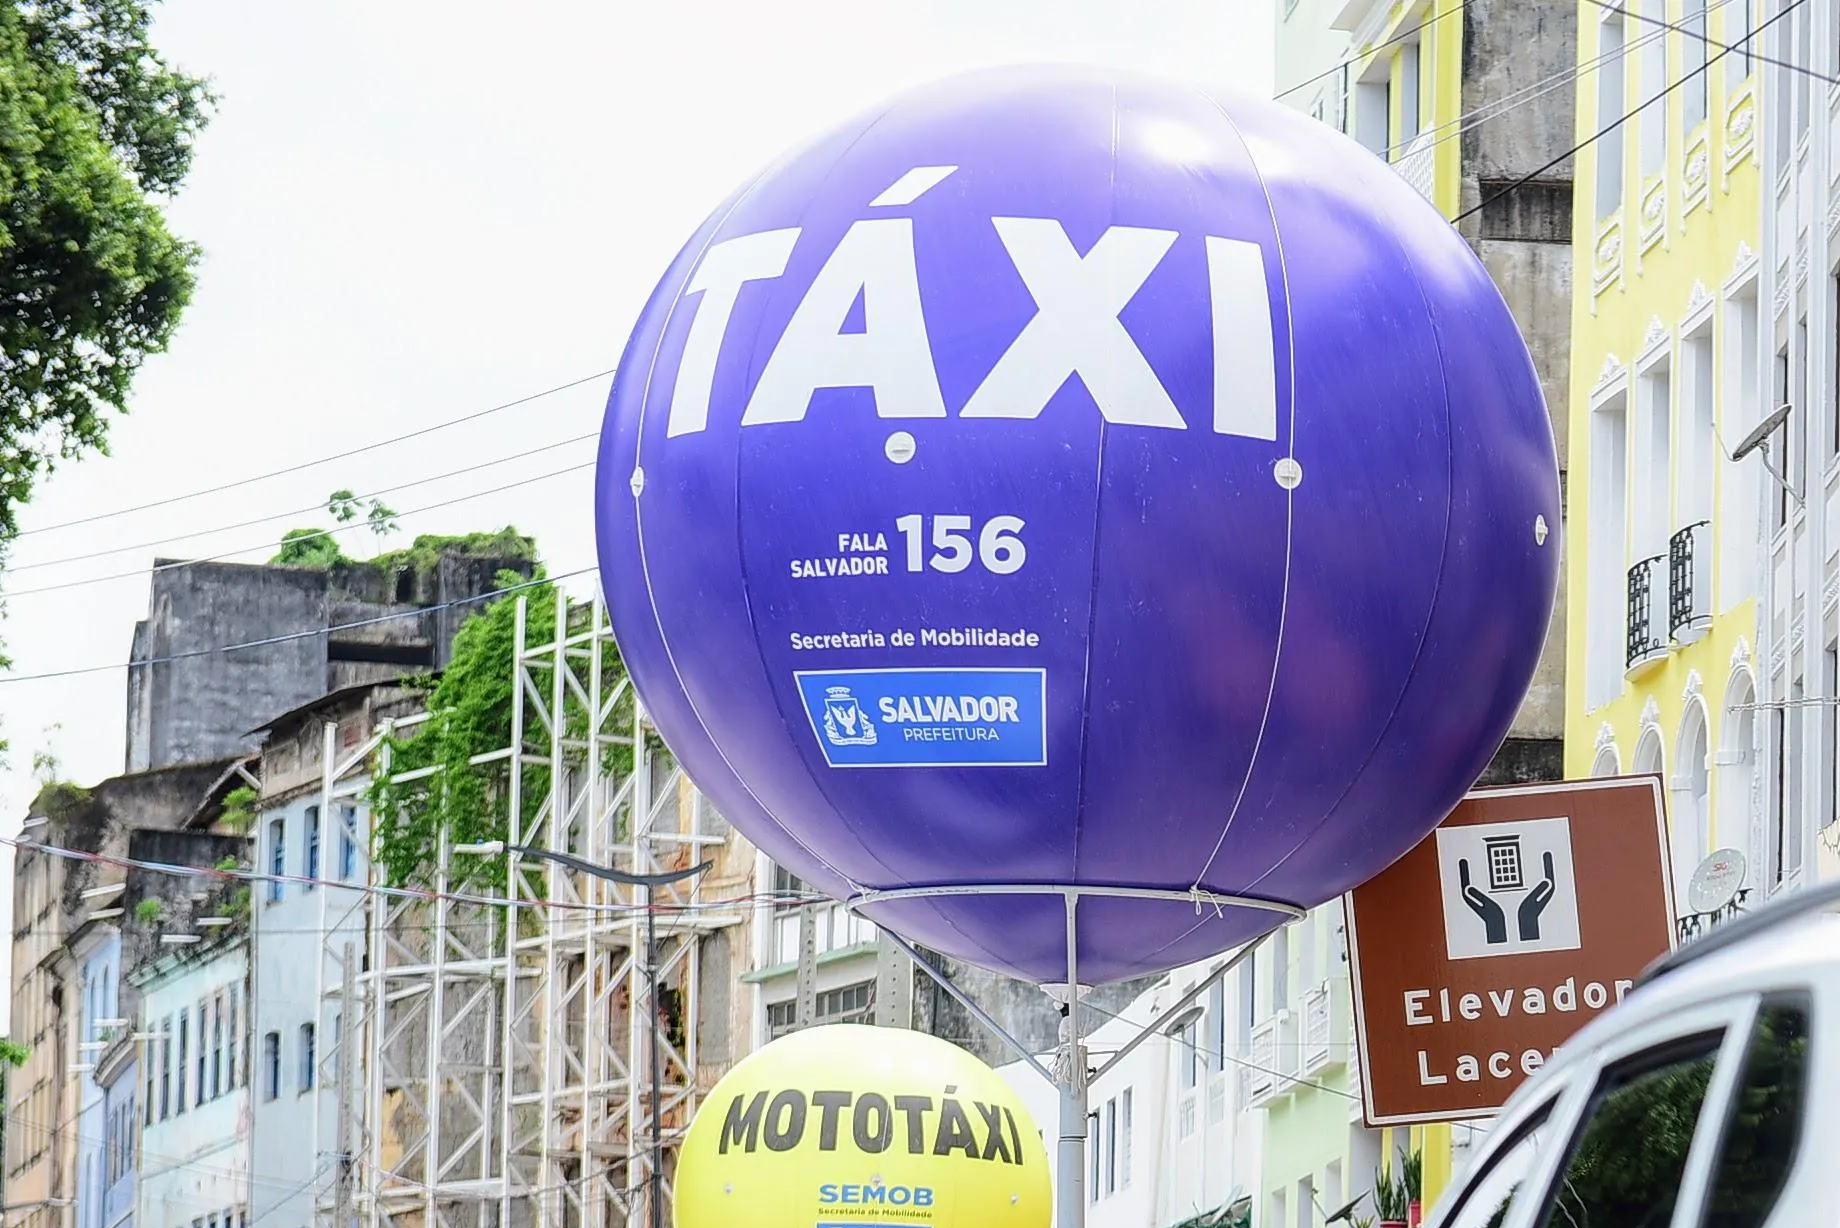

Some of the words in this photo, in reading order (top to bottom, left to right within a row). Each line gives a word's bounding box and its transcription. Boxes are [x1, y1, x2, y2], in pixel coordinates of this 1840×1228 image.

[667, 165, 1276, 441] TÁXI
[839, 533, 888, 552] FALA
[896, 514, 1027, 574] 156
[791, 557, 889, 577] SALVADOR
[790, 630, 885, 650] Secretaria
[891, 629, 915, 647] de
[921, 629, 1040, 648] Mobilidade
[879, 696, 1020, 723] SALVADOR
[903, 728, 999, 742] PREFEITURA
[1403, 977, 1635, 1027] Elevador
[718, 1085, 1024, 1166] MOTOTÁXI
[819, 1184, 934, 1206] SEMOB
[882, 1209, 932, 1219] Mobilidade
